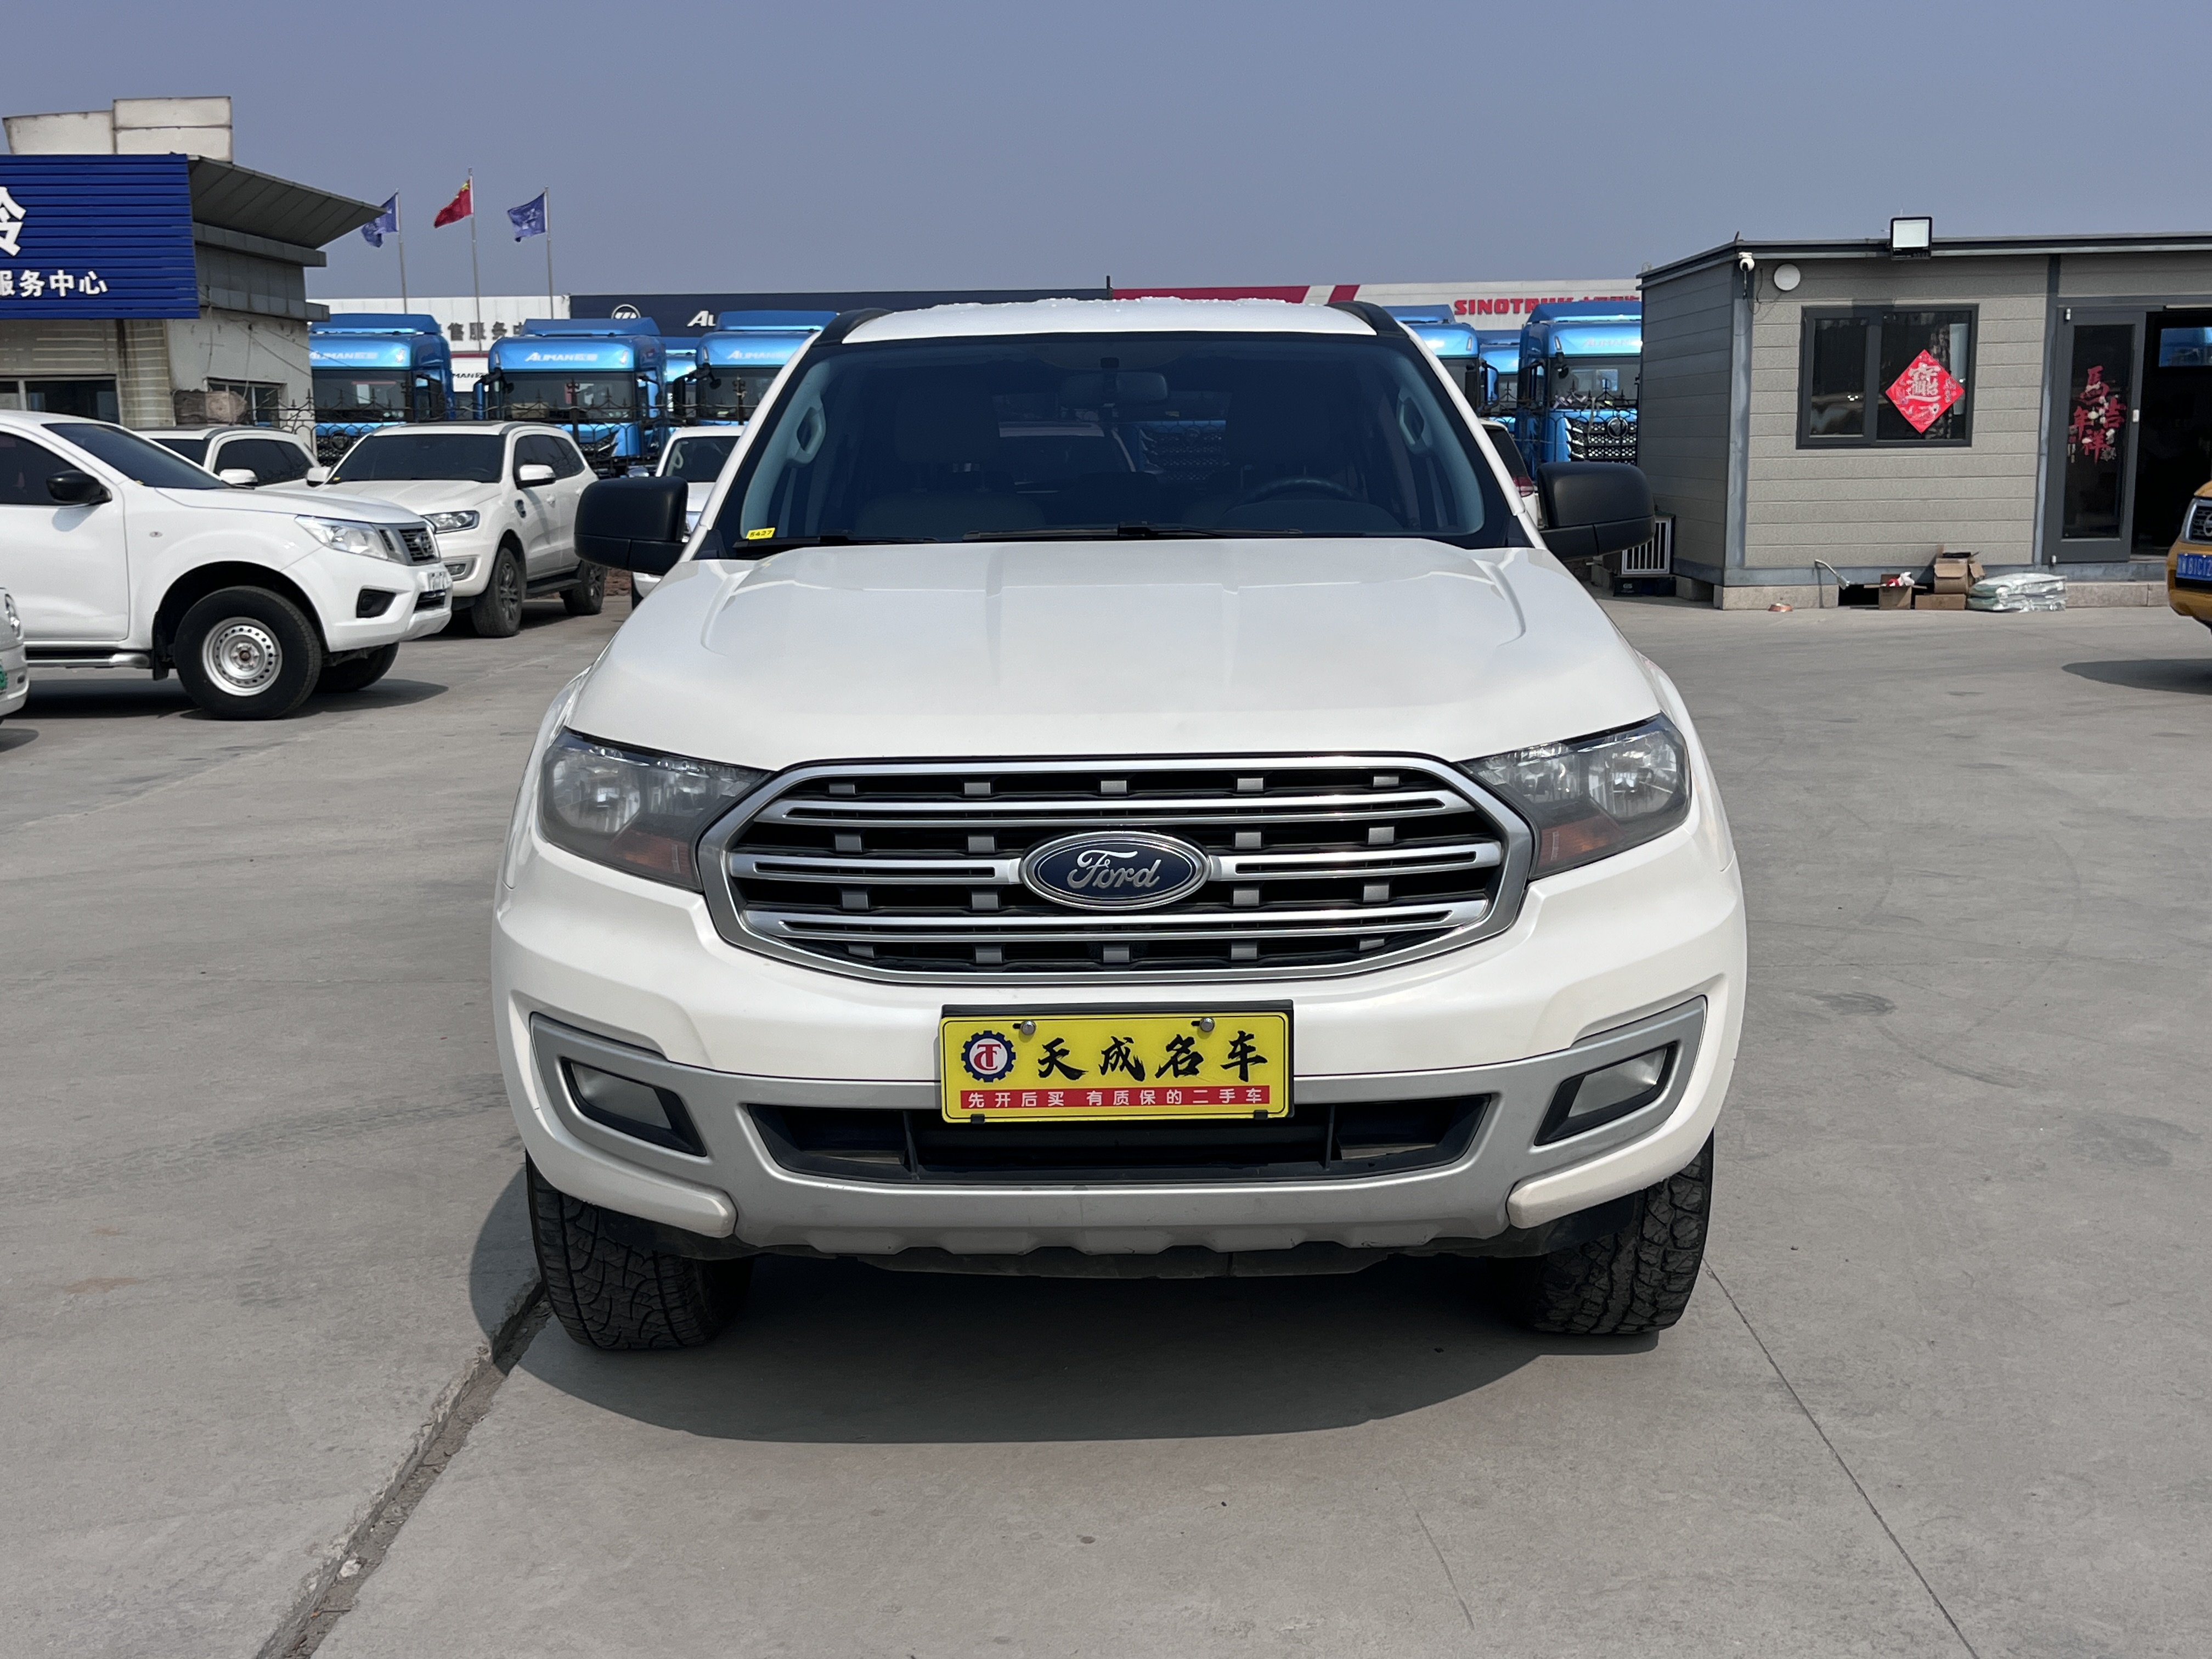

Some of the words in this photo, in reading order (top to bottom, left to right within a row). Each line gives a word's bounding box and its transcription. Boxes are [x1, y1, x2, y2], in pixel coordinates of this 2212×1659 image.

[1454, 296, 1573, 315] SINOTR
[1066, 849, 1161, 889] Ford
[1037, 1030, 1268, 1082] 天成名车
[968, 1091, 1065, 1108] 先开后买
[1086, 1088, 1262, 1106] 有质保的二手车
